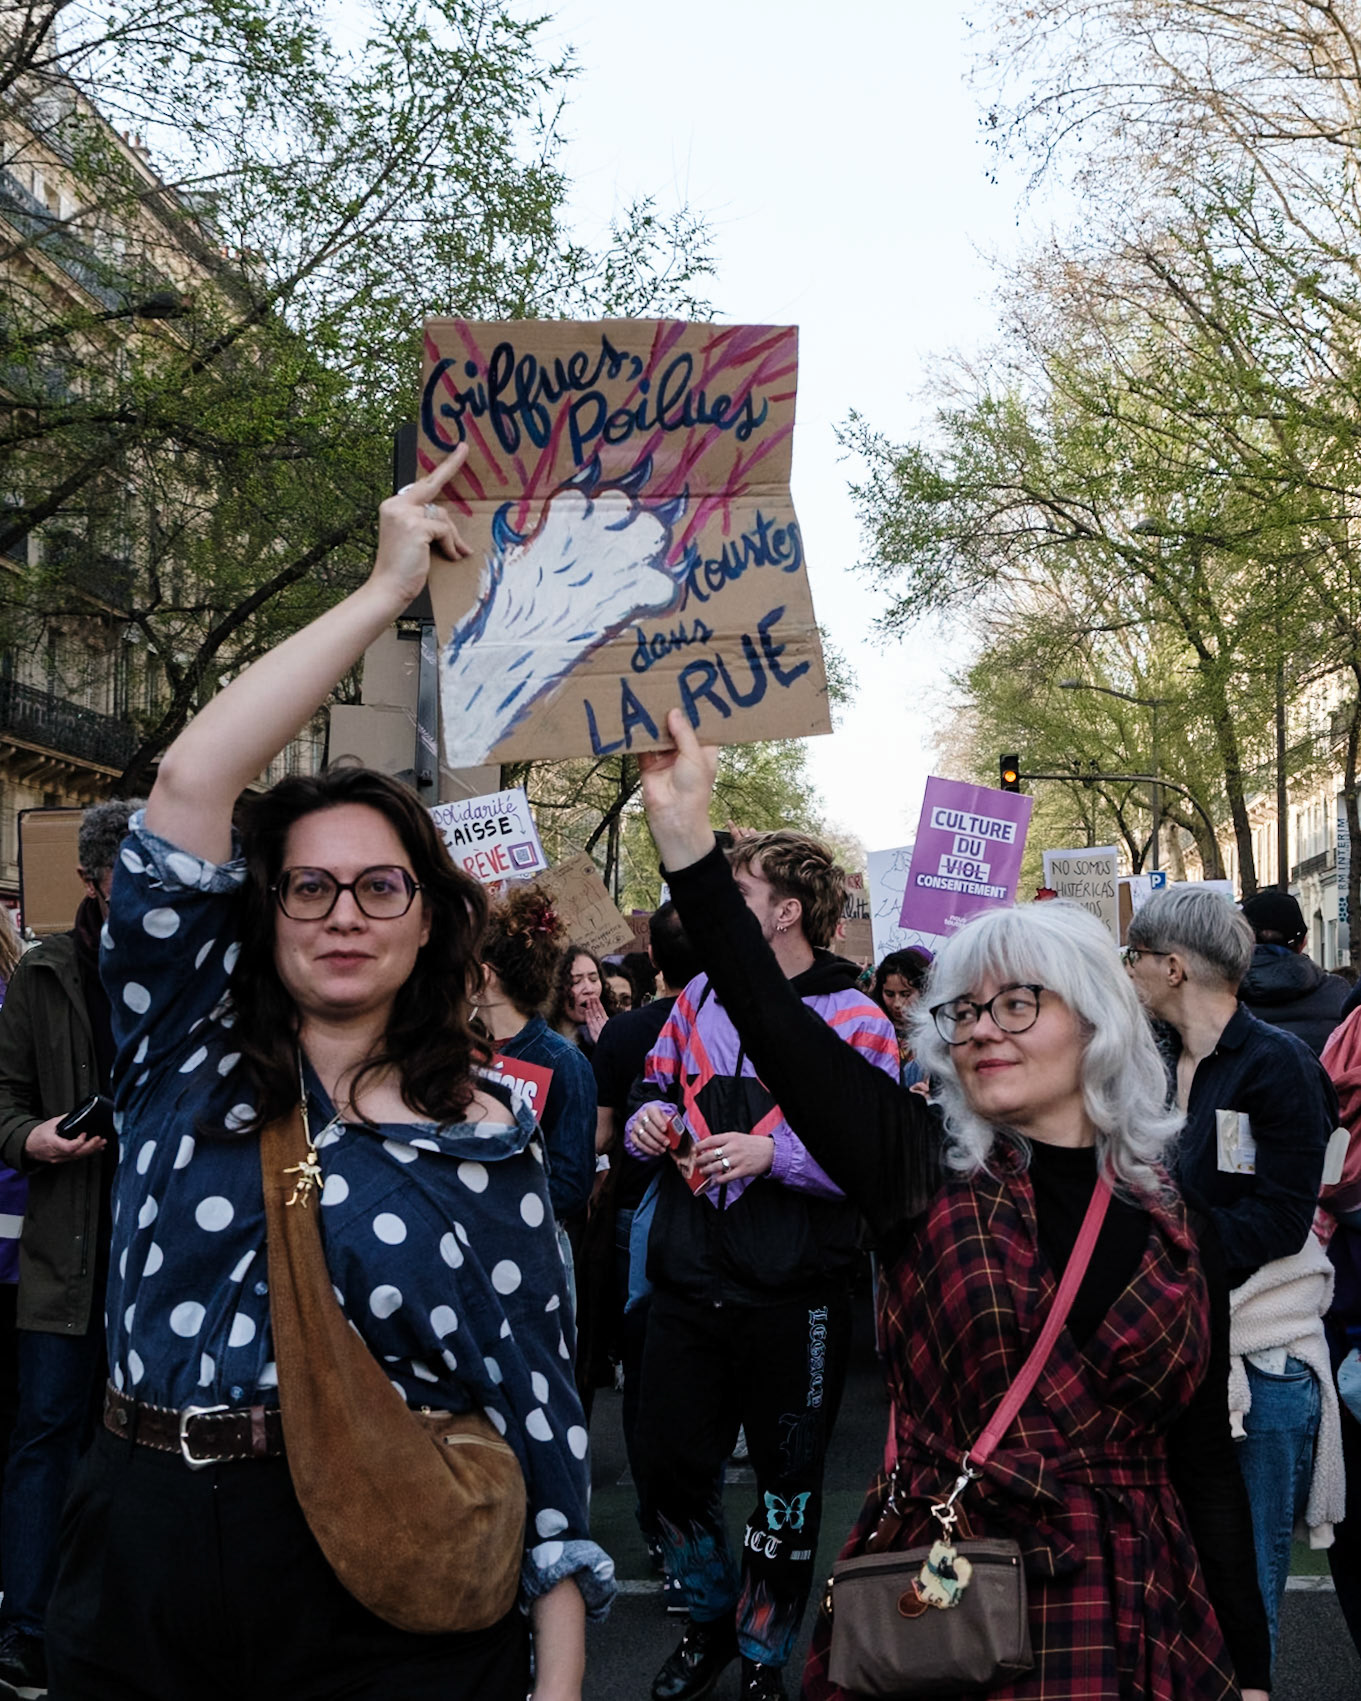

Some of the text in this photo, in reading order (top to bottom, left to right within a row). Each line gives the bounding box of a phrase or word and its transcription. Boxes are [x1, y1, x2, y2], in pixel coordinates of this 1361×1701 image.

[568, 352, 772, 466] Poilues
[631, 617, 713, 673] dans
[583, 605, 810, 756] LA RUE
[934, 809, 1013, 841] CULTURE
[956, 837, 982, 857] DU
[1336, 817, 1347, 871] INTERIM
[944, 858, 985, 881] VIOL
[1051, 860, 1112, 876] NO SOMOS
[1151, 875, 1162, 888] P
[916, 873, 1008, 900] CONSENTEMENT
[1055, 879, 1116, 898] HISTÉRICAS
